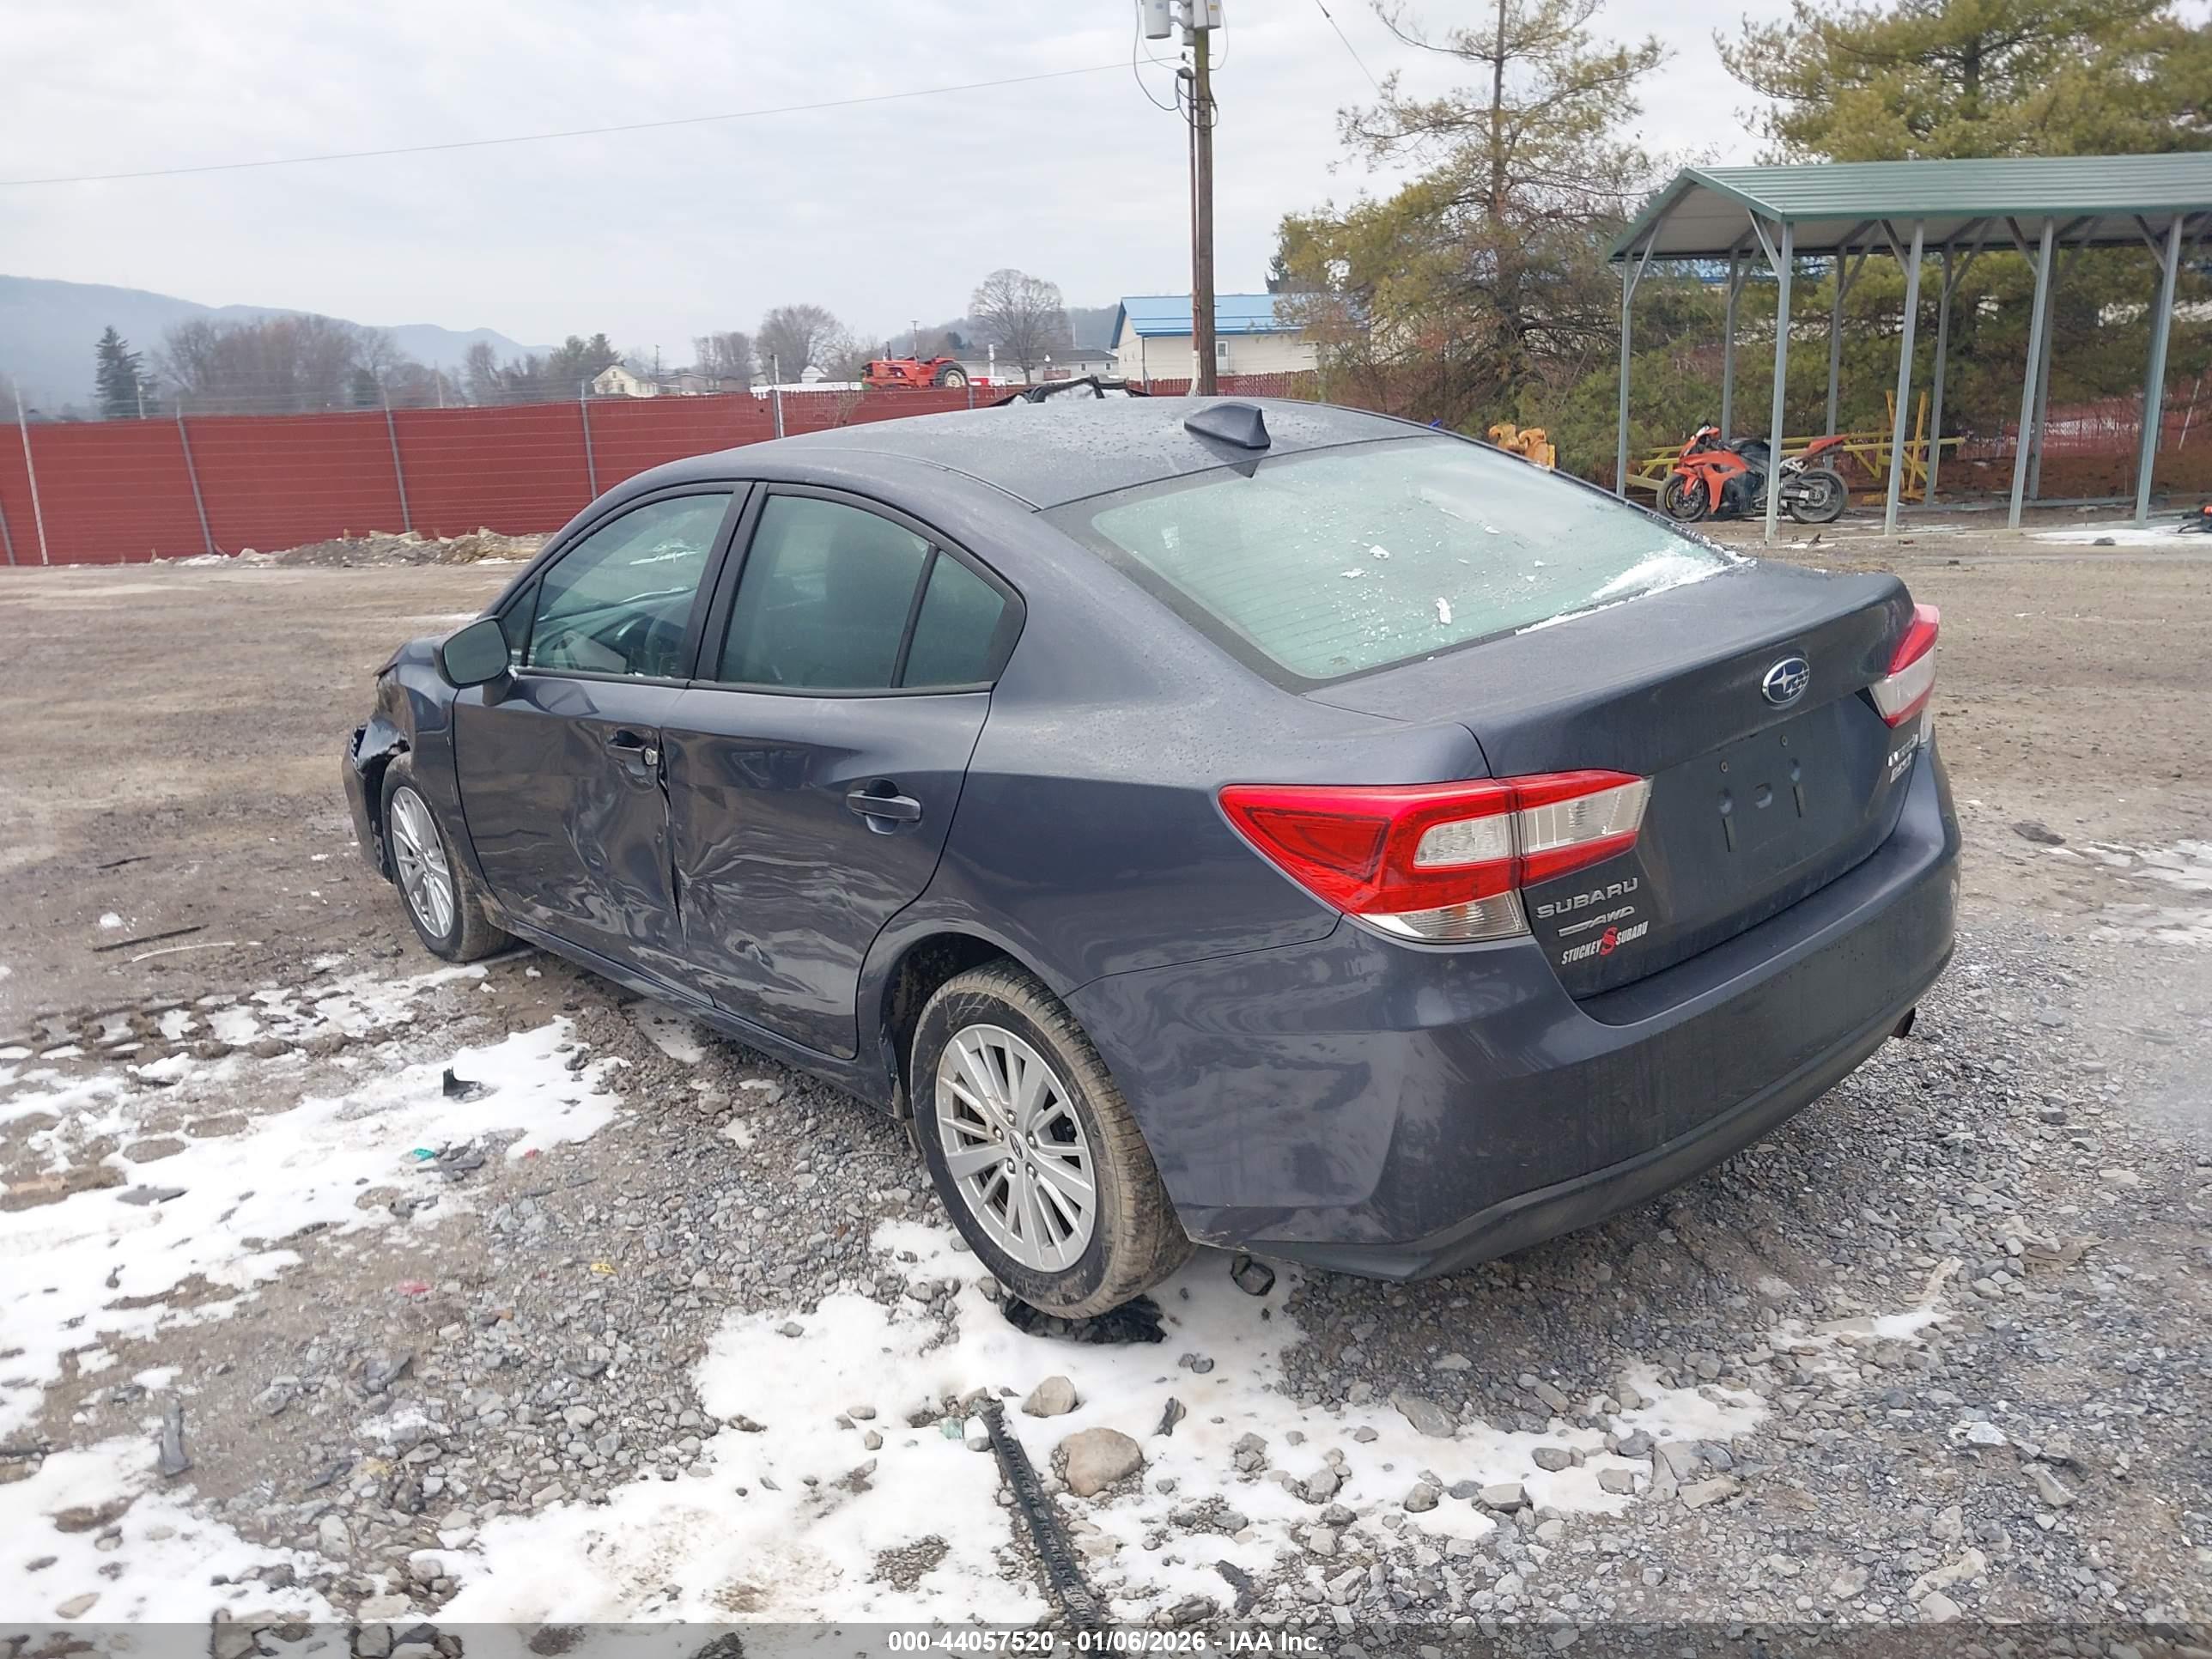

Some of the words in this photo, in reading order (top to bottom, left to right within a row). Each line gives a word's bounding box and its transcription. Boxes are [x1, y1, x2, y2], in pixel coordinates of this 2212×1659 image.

[1536, 877, 1638, 919] SUBARU
[1591, 905, 1635, 927] AWD
[1561, 938, 1602, 965] STUCKEY
[1615, 921, 1649, 945] SUBARU
